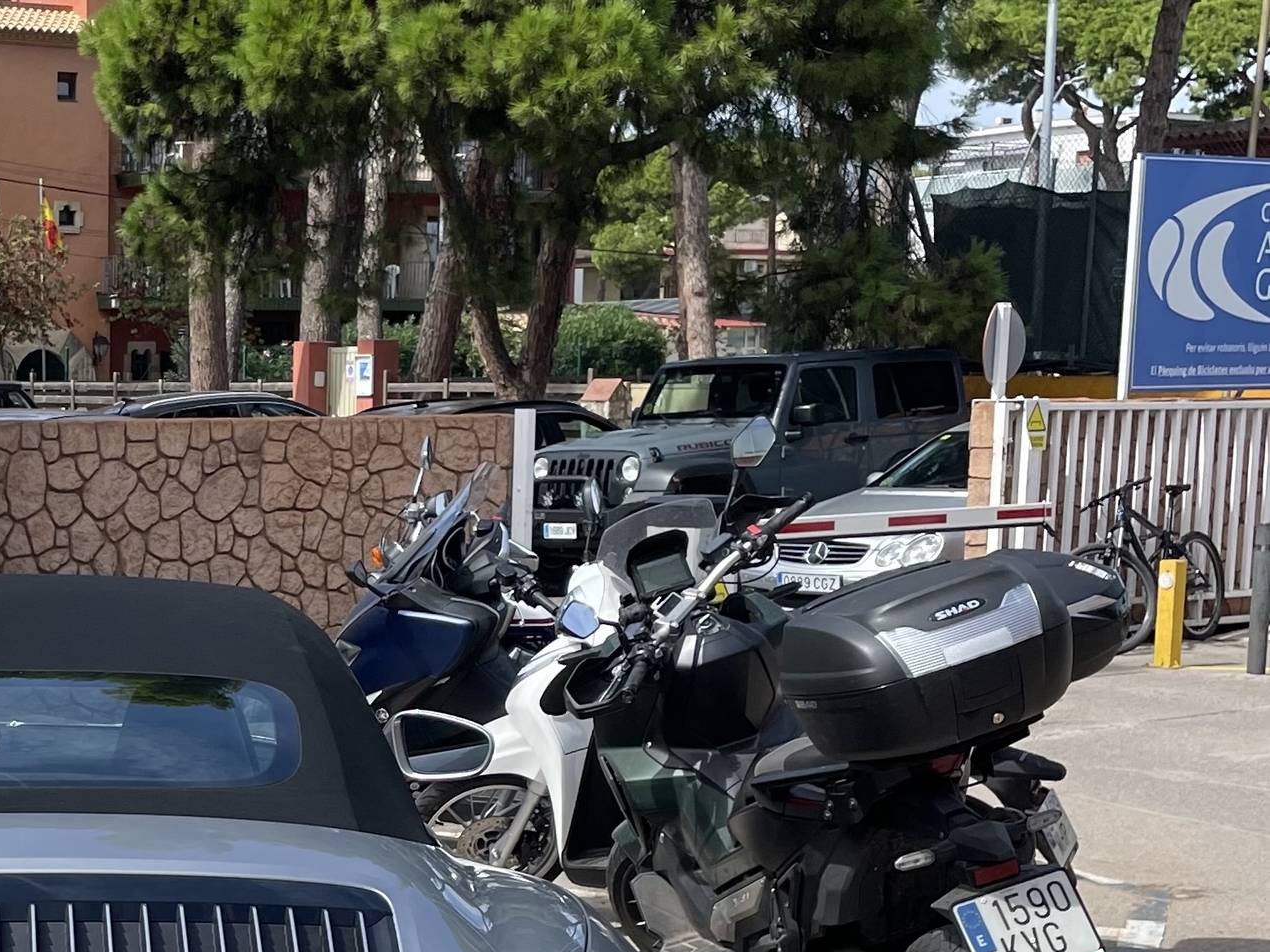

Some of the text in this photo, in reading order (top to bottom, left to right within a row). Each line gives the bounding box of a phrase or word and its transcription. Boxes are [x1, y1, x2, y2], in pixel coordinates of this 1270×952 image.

[1185, 342, 1197, 353] Per
[1197, 342, 1217, 353] evitar
[1150, 365, 1157, 376] El
[1188, 365, 1197, 376] de
[1255, 366, 1267, 377] per
[676, 438, 733, 451] RUBICO
[934, 599, 980, 621] SHAD
[992, 880, 1072, 931] 1590
[975, 933, 988, 948] E
